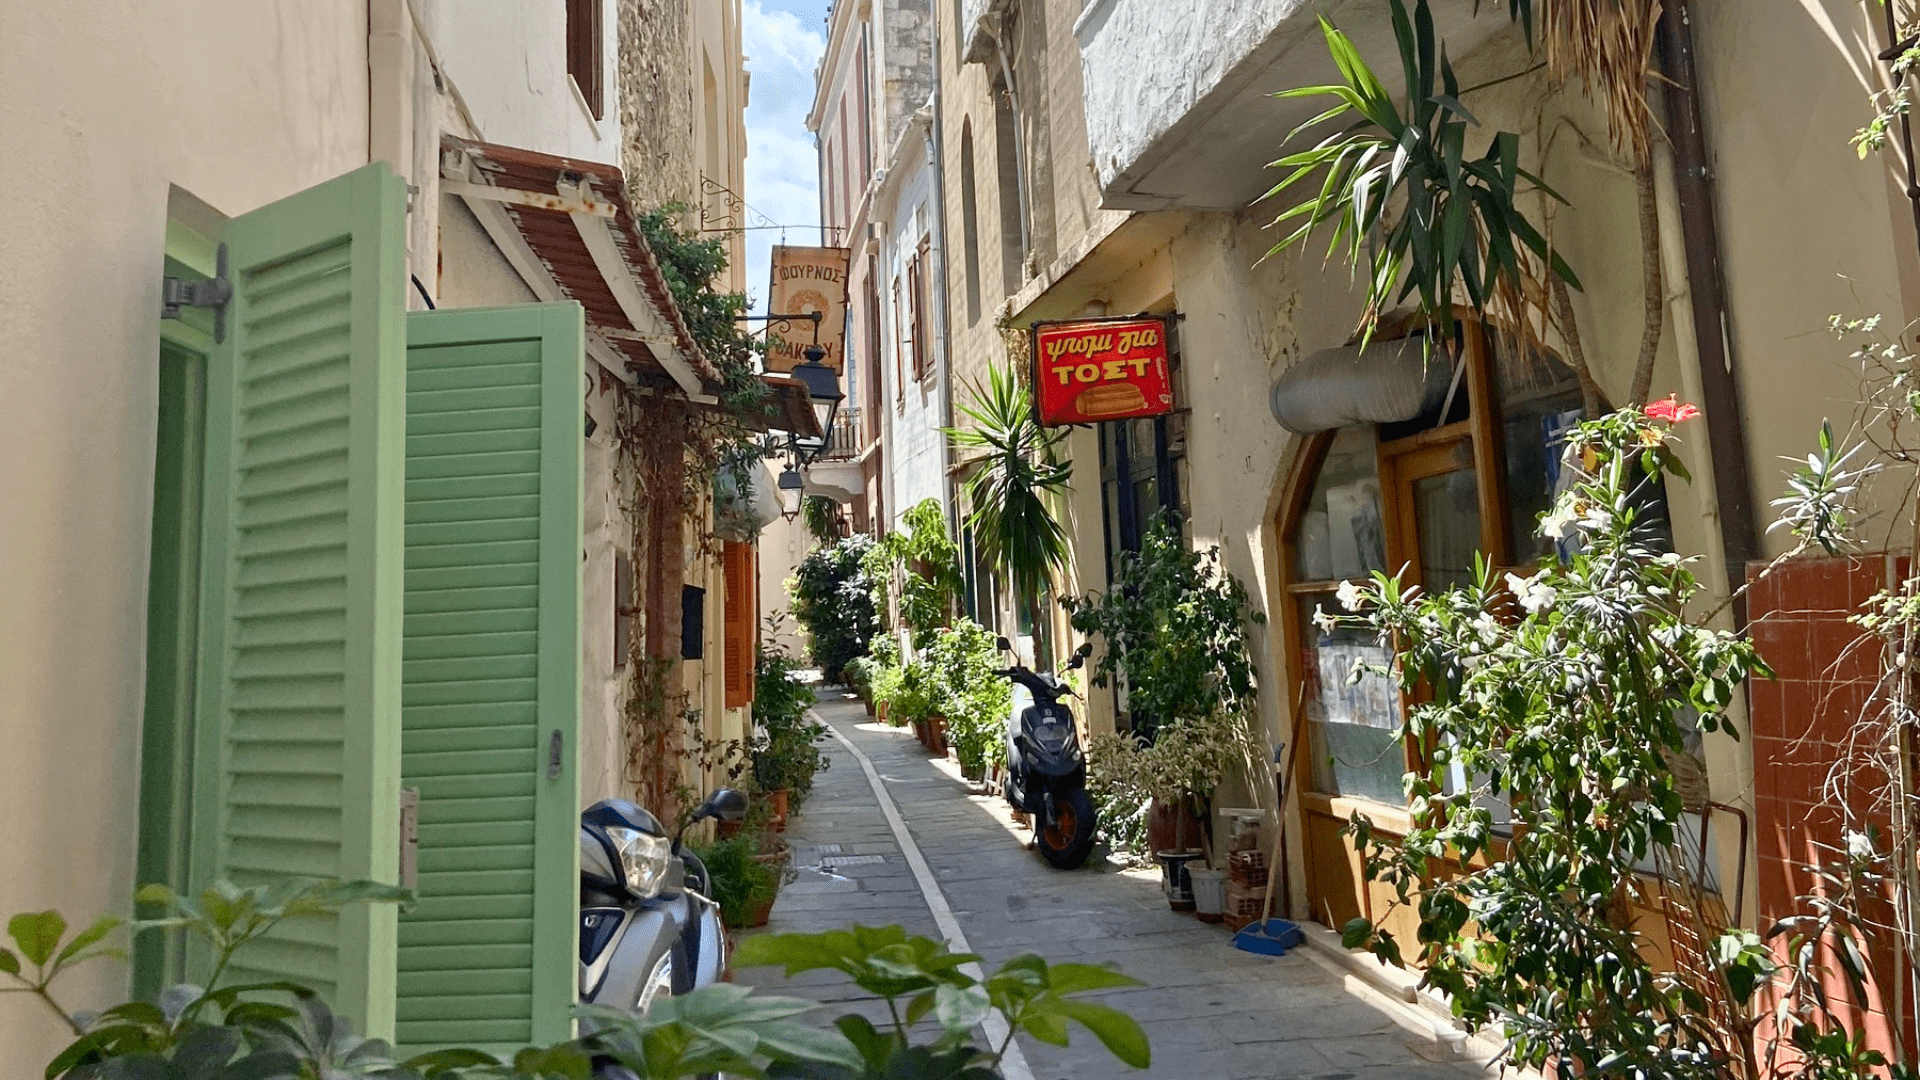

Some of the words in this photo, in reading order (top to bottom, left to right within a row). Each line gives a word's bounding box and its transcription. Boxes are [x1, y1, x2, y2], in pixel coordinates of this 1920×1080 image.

[779, 264, 842, 284] ΦΟΥΡΝΟΣ
[1118, 329, 1158, 354] για
[1052, 358, 1151, 385] ΤΟΣΤ
